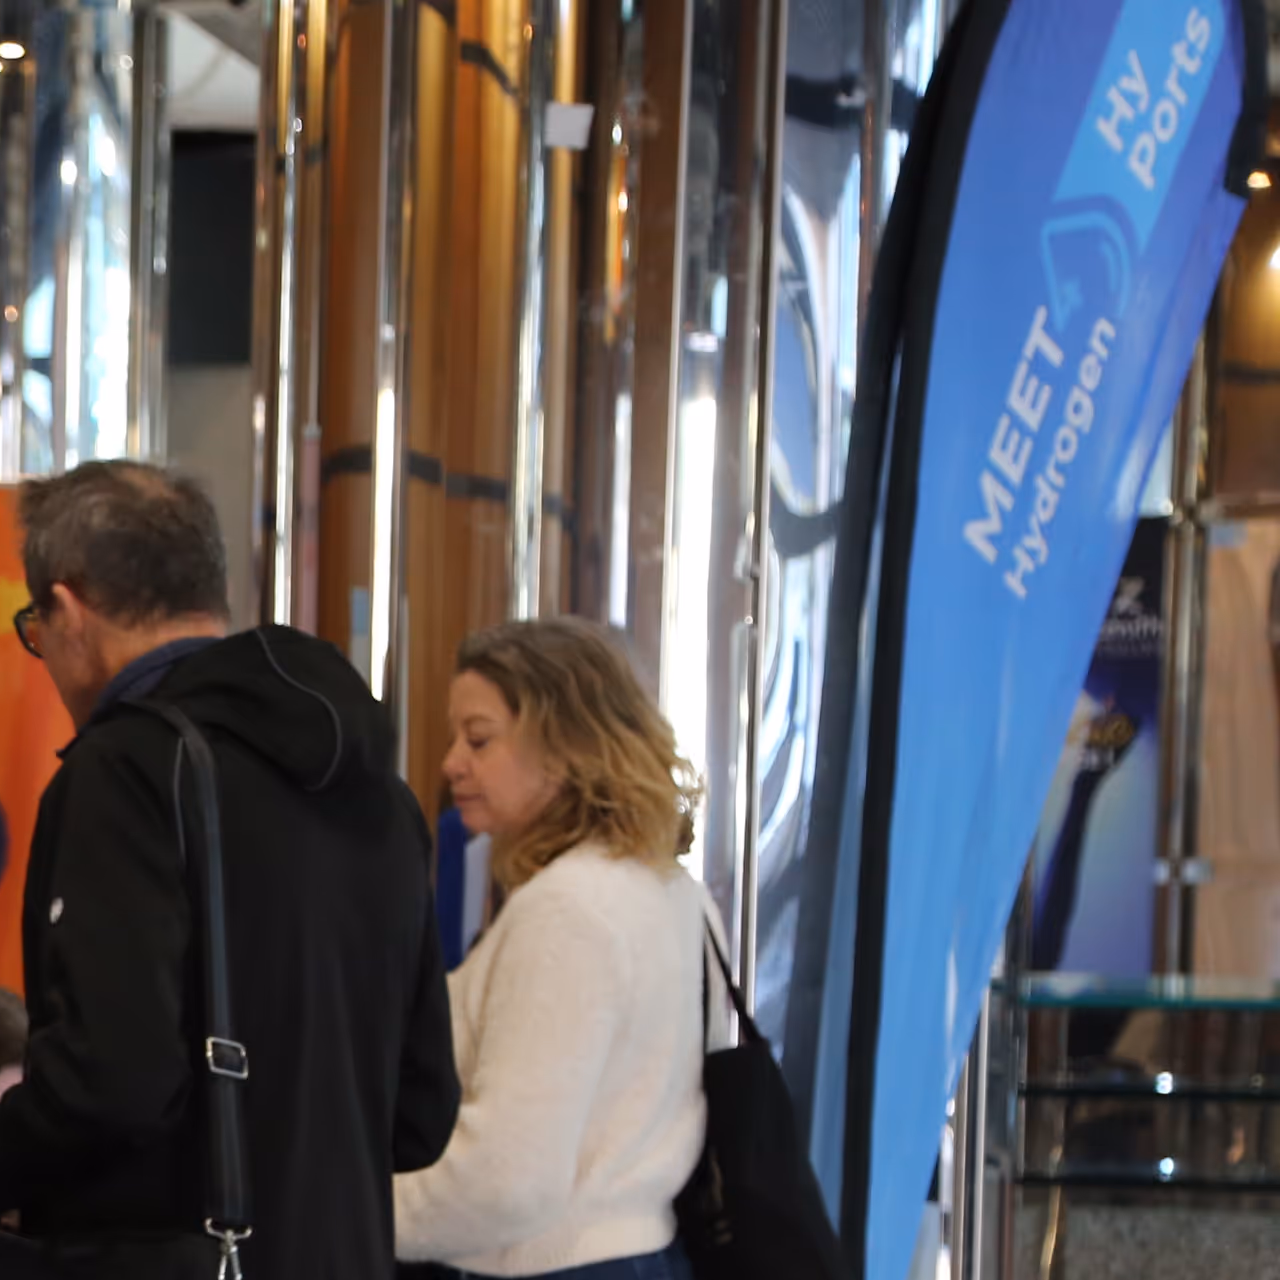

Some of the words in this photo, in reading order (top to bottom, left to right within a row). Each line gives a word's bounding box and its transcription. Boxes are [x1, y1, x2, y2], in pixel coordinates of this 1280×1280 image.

[1096, 48, 1150, 153] Hy
[1128, 7, 1211, 190] Ports
[1004, 317, 1116, 600] Hydrogen
